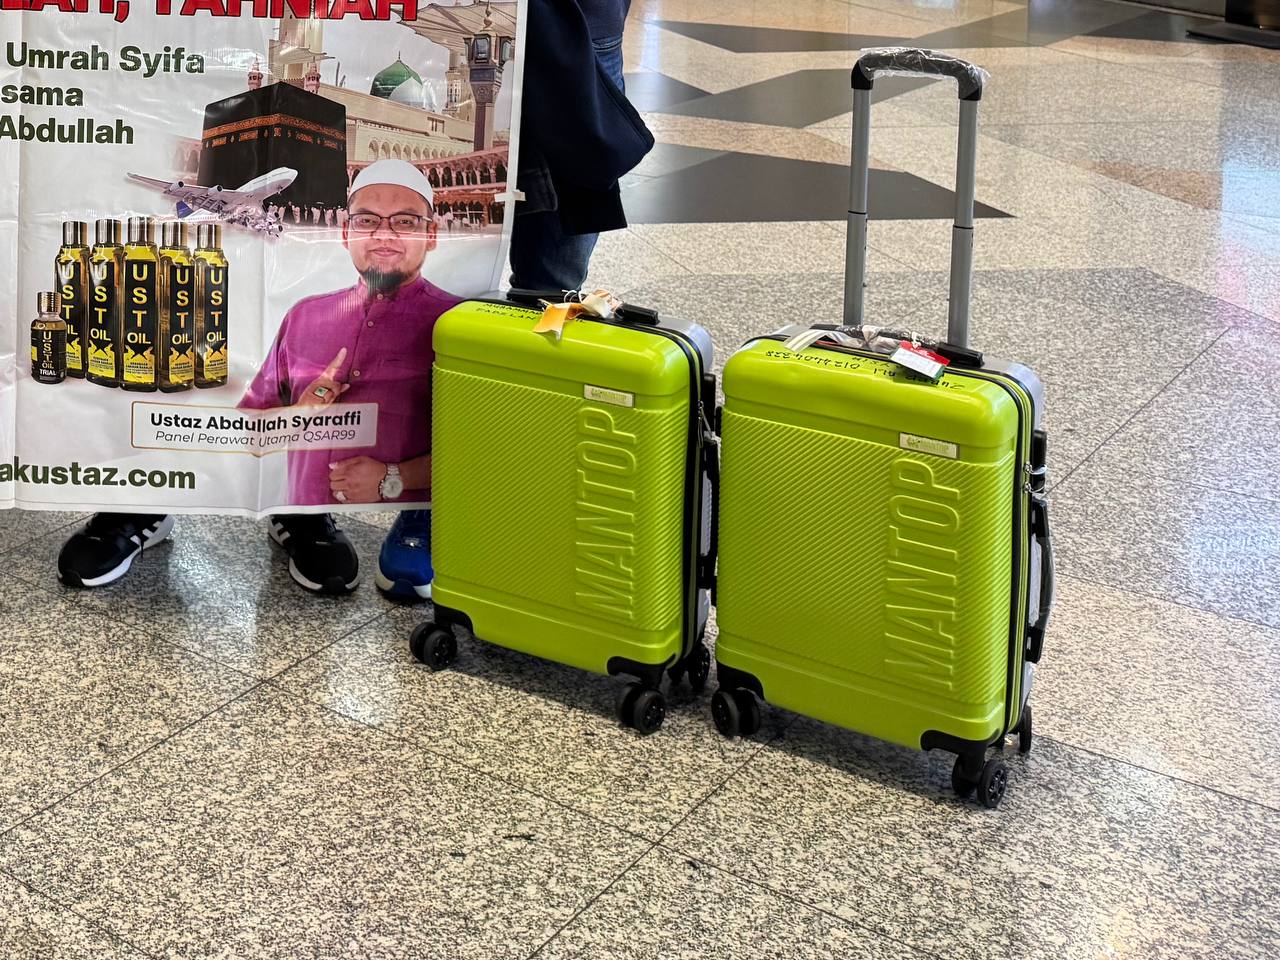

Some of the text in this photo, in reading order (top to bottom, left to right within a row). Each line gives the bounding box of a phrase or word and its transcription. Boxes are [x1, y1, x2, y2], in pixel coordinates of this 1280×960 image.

[6, 42, 110, 71] Umrah
[119, 44, 206, 78] Syifa
[66, 324, 78, 336] IL
[90, 327, 112, 341] OIL
[206, 331, 226, 342] OIL
[126, 331, 152, 345] OIL
[172, 331, 192, 345] OIL
[39, 368, 57, 376] TRIAL
[150, 410, 361, 433] Ustaz Abdullah Syaraffi
[155, 429, 356, 447] Panel Perawat Utama QSAR99
[575, 406, 637, 620] MANTOP
[884, 458, 960, 692] MANTOP
